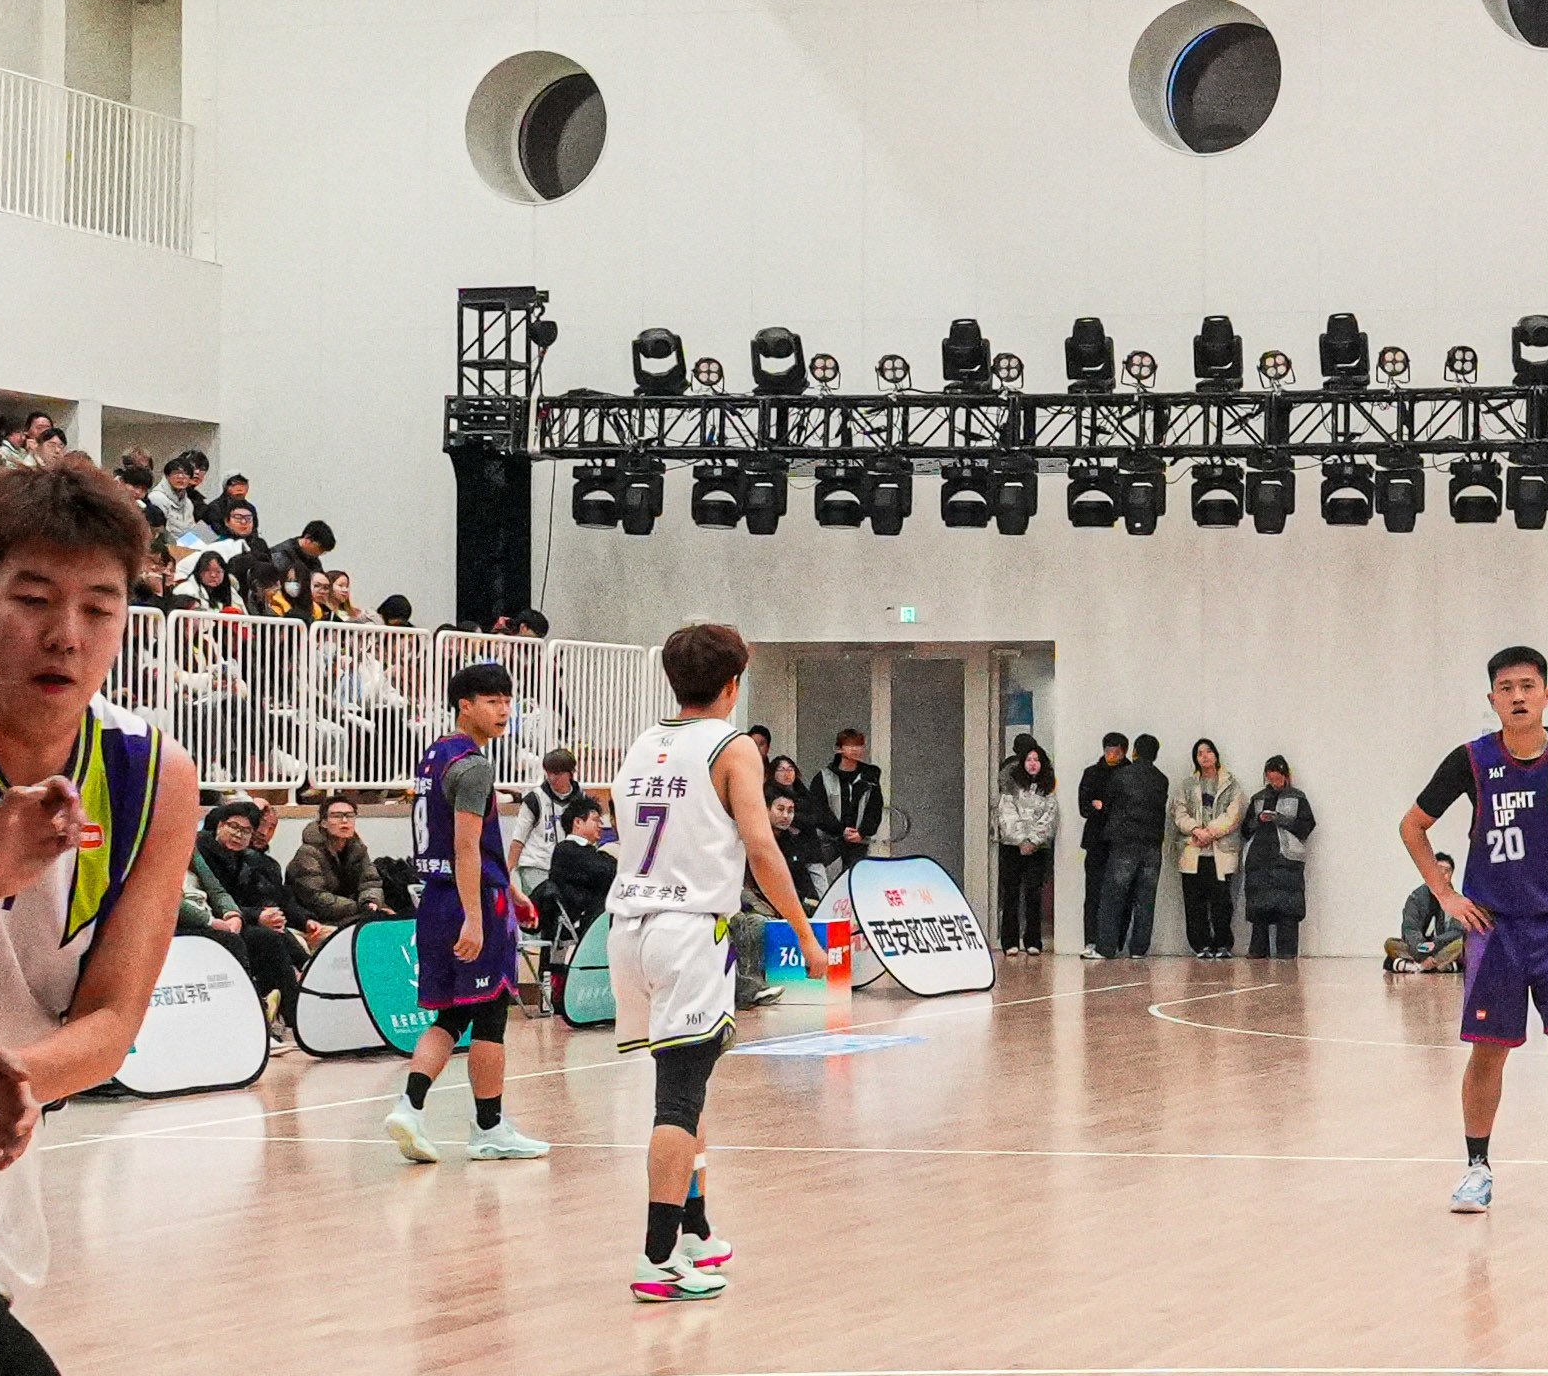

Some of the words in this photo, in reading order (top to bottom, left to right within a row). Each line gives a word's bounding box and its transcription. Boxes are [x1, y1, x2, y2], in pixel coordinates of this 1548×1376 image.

[626, 776, 688, 798] 王浩伟
[1492, 791, 1535, 811] LIGHT
[1494, 809, 1516, 827] UP
[635, 802, 670, 878] 7
[1486, 827, 1526, 863] 20
[867, 914, 983, 958] 西安欧亚学院
